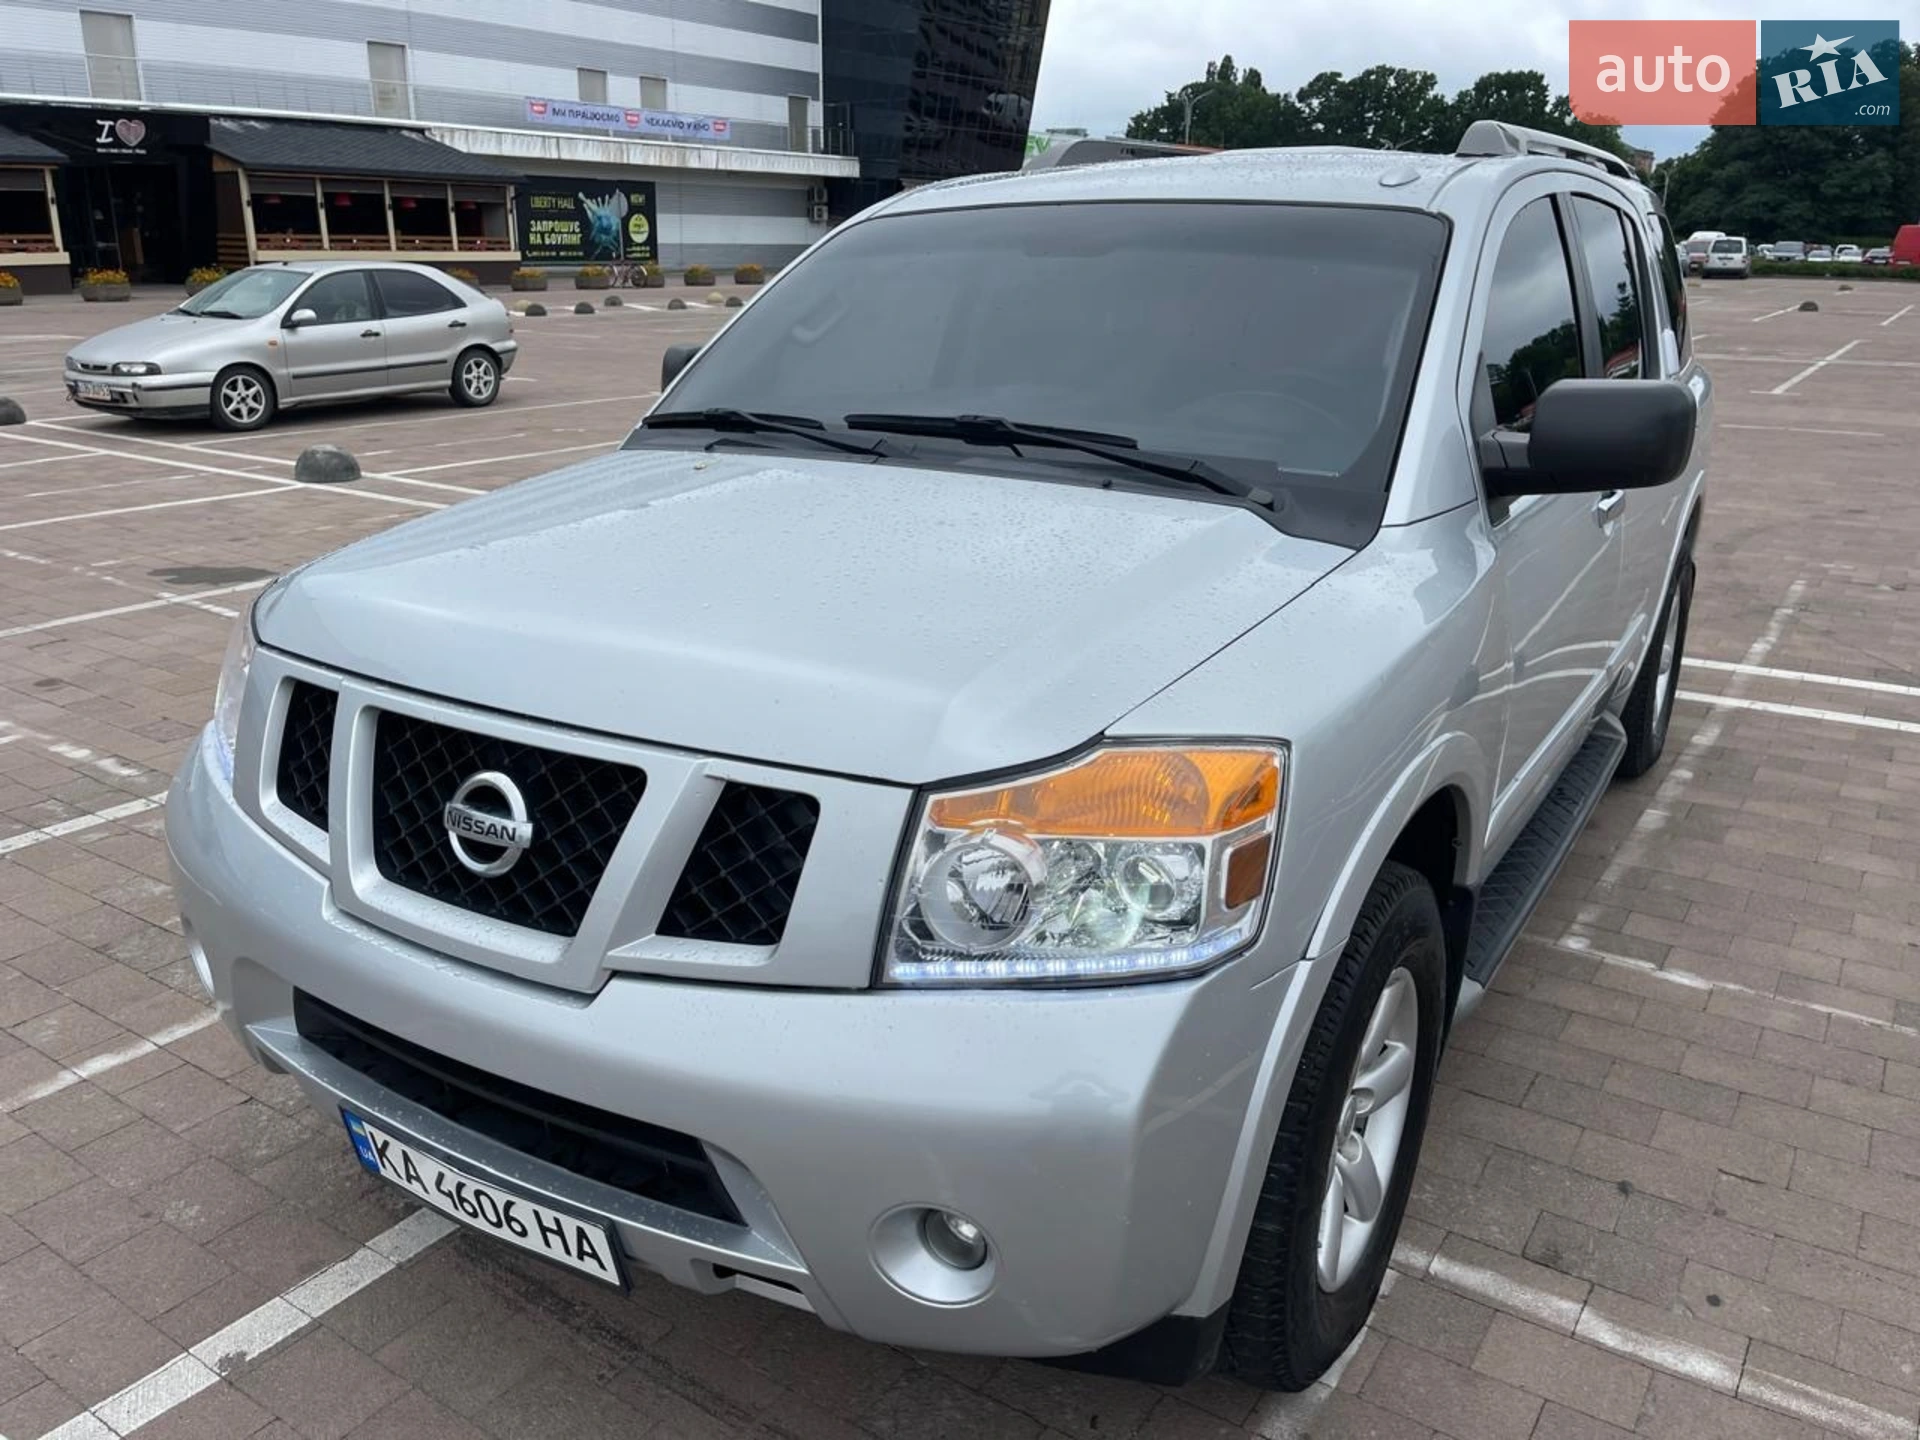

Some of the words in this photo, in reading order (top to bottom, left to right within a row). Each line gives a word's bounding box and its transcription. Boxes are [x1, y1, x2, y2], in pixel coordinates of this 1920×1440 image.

[529, 219, 581, 232] ЗАПРОШУЄ
[529, 233, 543, 245] НА
[544, 233, 583, 245] БОУЛІНГ
[446, 811, 517, 841] NISSAN
[368, 1131, 431, 1195] KA
[434, 1170, 529, 1239] 4606
[532, 1208, 608, 1272] HA
